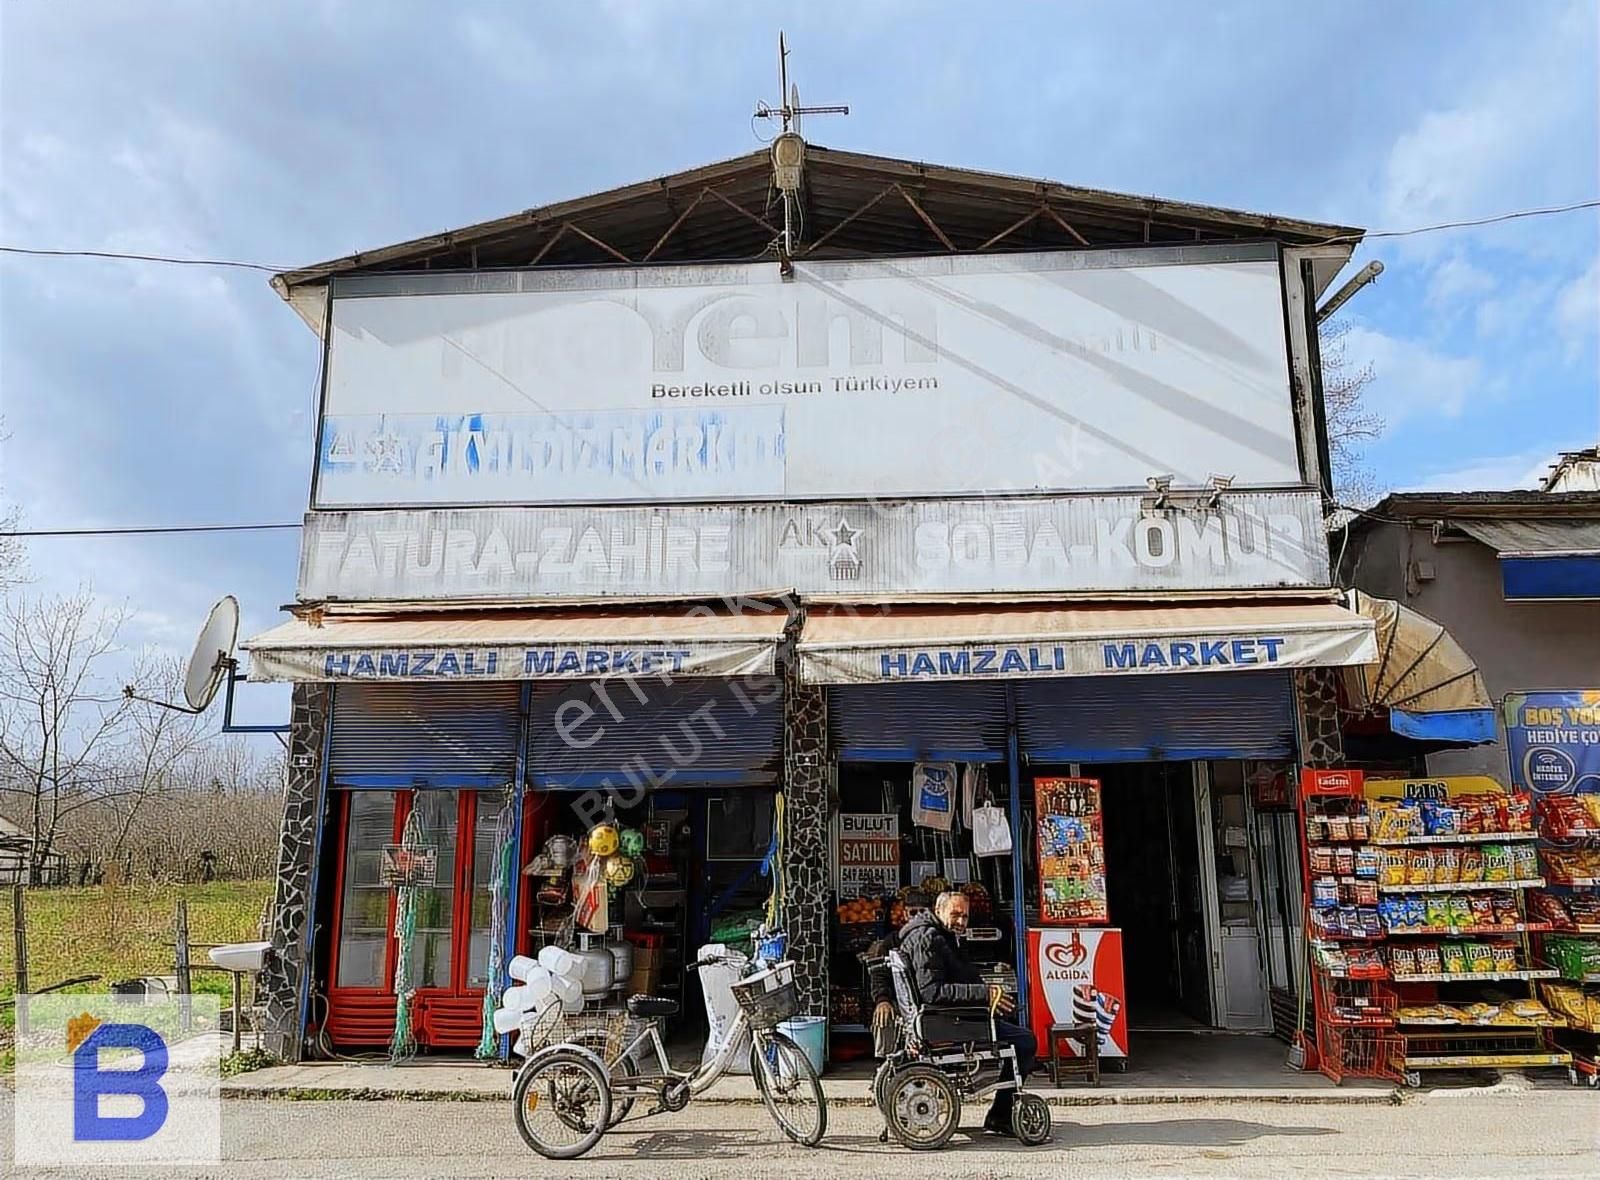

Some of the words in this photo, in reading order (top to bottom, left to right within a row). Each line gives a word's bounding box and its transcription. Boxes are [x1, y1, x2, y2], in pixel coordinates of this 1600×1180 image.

[651, 381, 751, 398] Bereketli
[759, 379, 822, 396] olsun
[831, 374, 939, 394] Türkiyem
[325, 651, 497, 677] HAMZALI
[524, 650, 690, 675] MARKET
[882, 646, 1065, 677] HAMZALI
[1104, 637, 1284, 668] MARKET
[1525, 708, 1563, 729] BOŞ
[1527, 728, 1579, 744] HEDİYE
[1581, 731, 1600, 746] ÇO
[843, 817, 893, 831] BULUT
[843, 843, 894, 861] SATILIK
